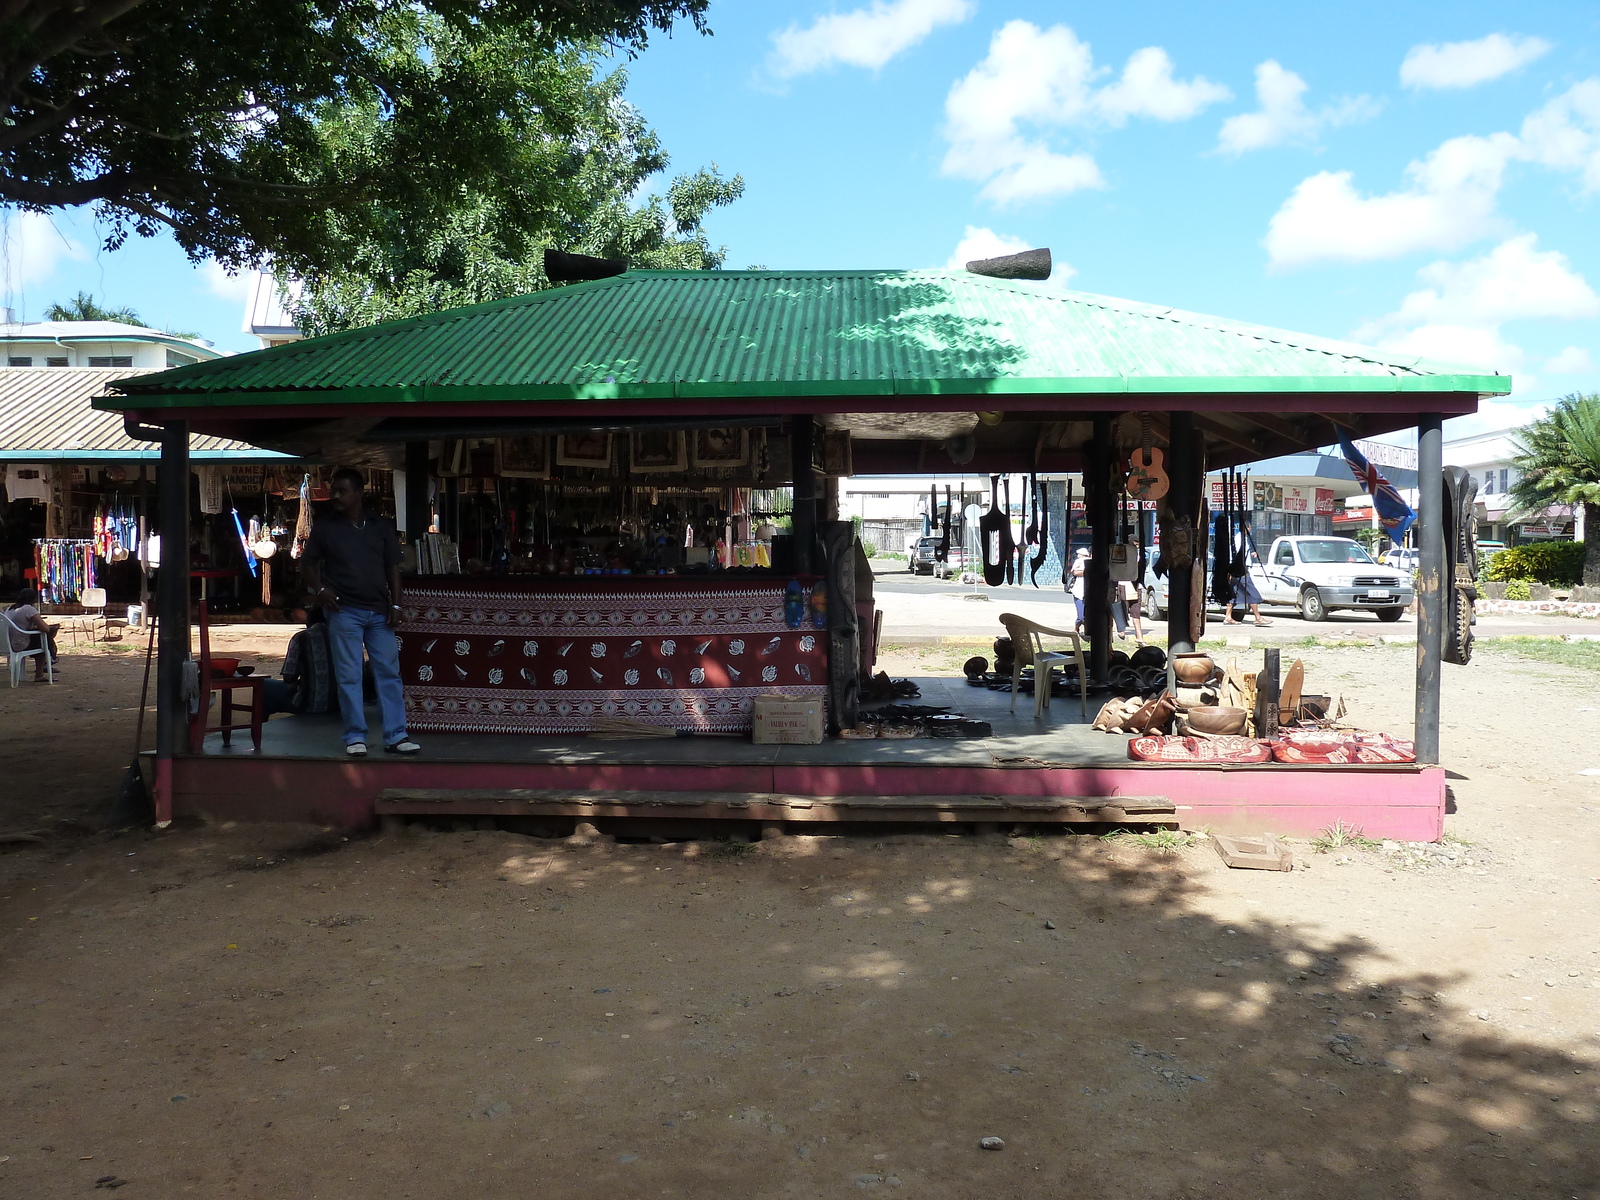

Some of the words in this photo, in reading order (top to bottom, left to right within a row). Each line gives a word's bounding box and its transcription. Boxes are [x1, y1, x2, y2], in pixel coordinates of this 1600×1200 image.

[1388, 446, 1402, 467] NIGHT
[1402, 450, 1417, 470] CLUB
[1292, 488, 1301, 497] The
[1284, 497, 1298, 511] BOTTLE
[1298, 499, 1308, 511] SHOP
